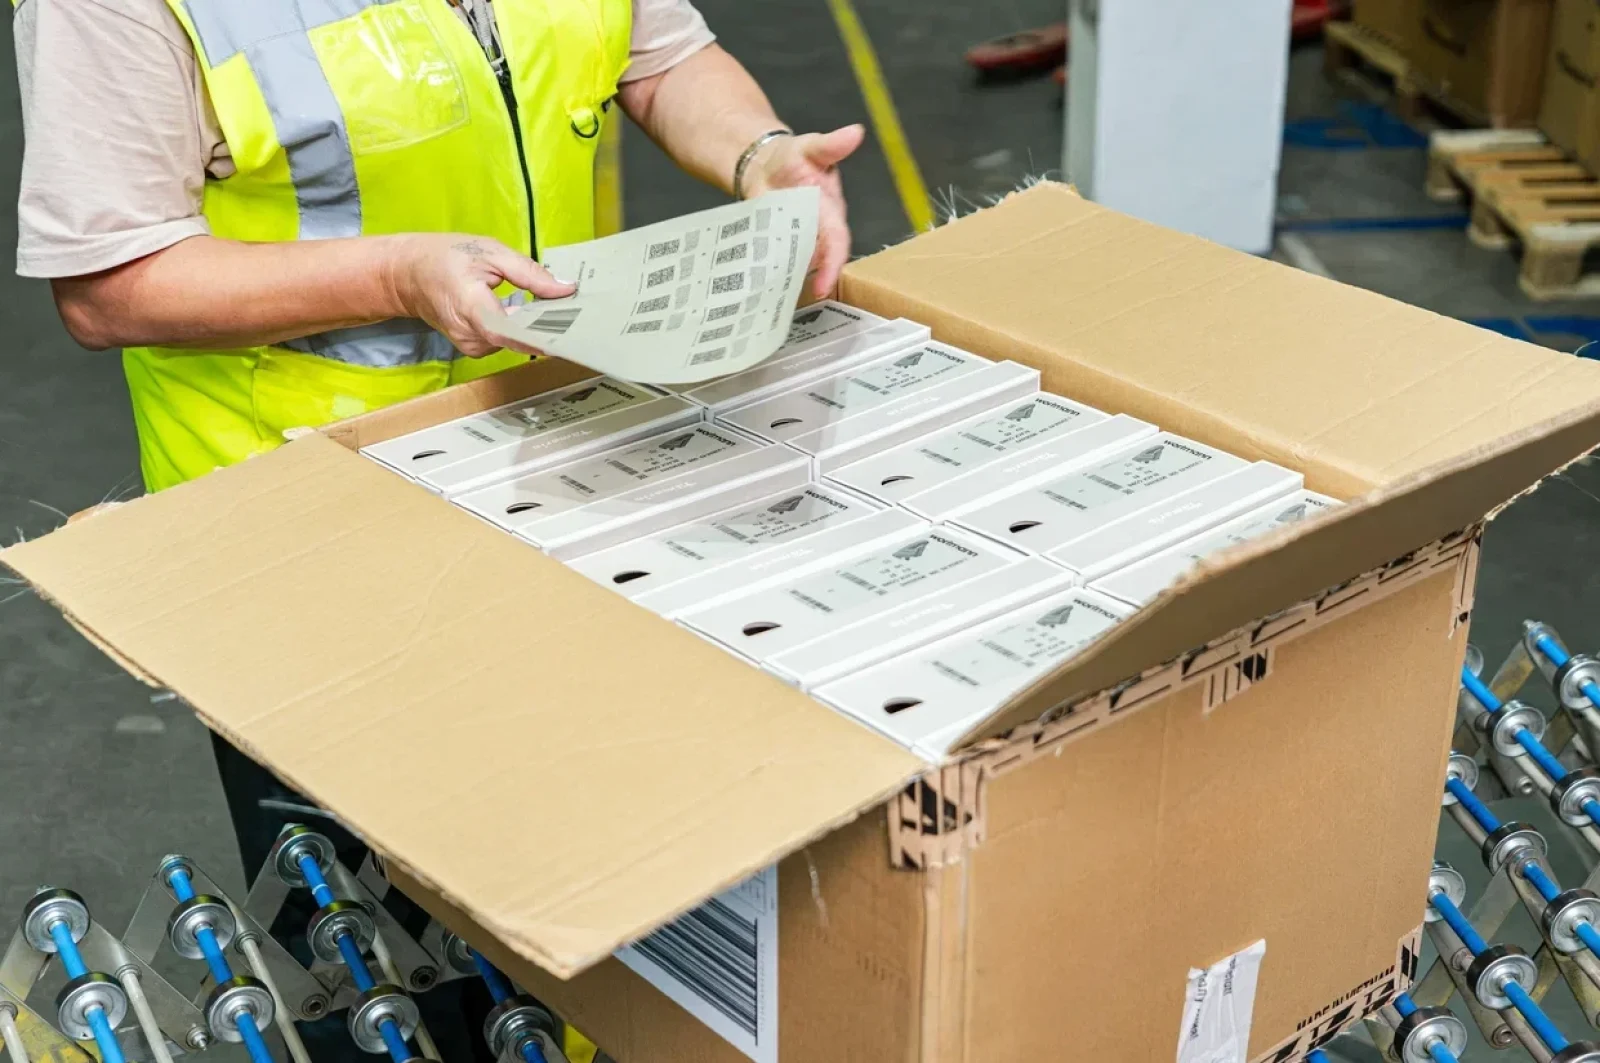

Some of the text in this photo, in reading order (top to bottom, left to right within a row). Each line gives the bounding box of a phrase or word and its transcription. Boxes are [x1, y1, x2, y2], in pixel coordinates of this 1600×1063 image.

[924, 346, 966, 364] wortmann
[1035, 398, 1081, 416] wortmann
[696, 431, 737, 447] wortmann
[1163, 439, 1213, 460] wortmann
[804, 489, 849, 511] wortmann
[929, 534, 979, 557] wortmann
